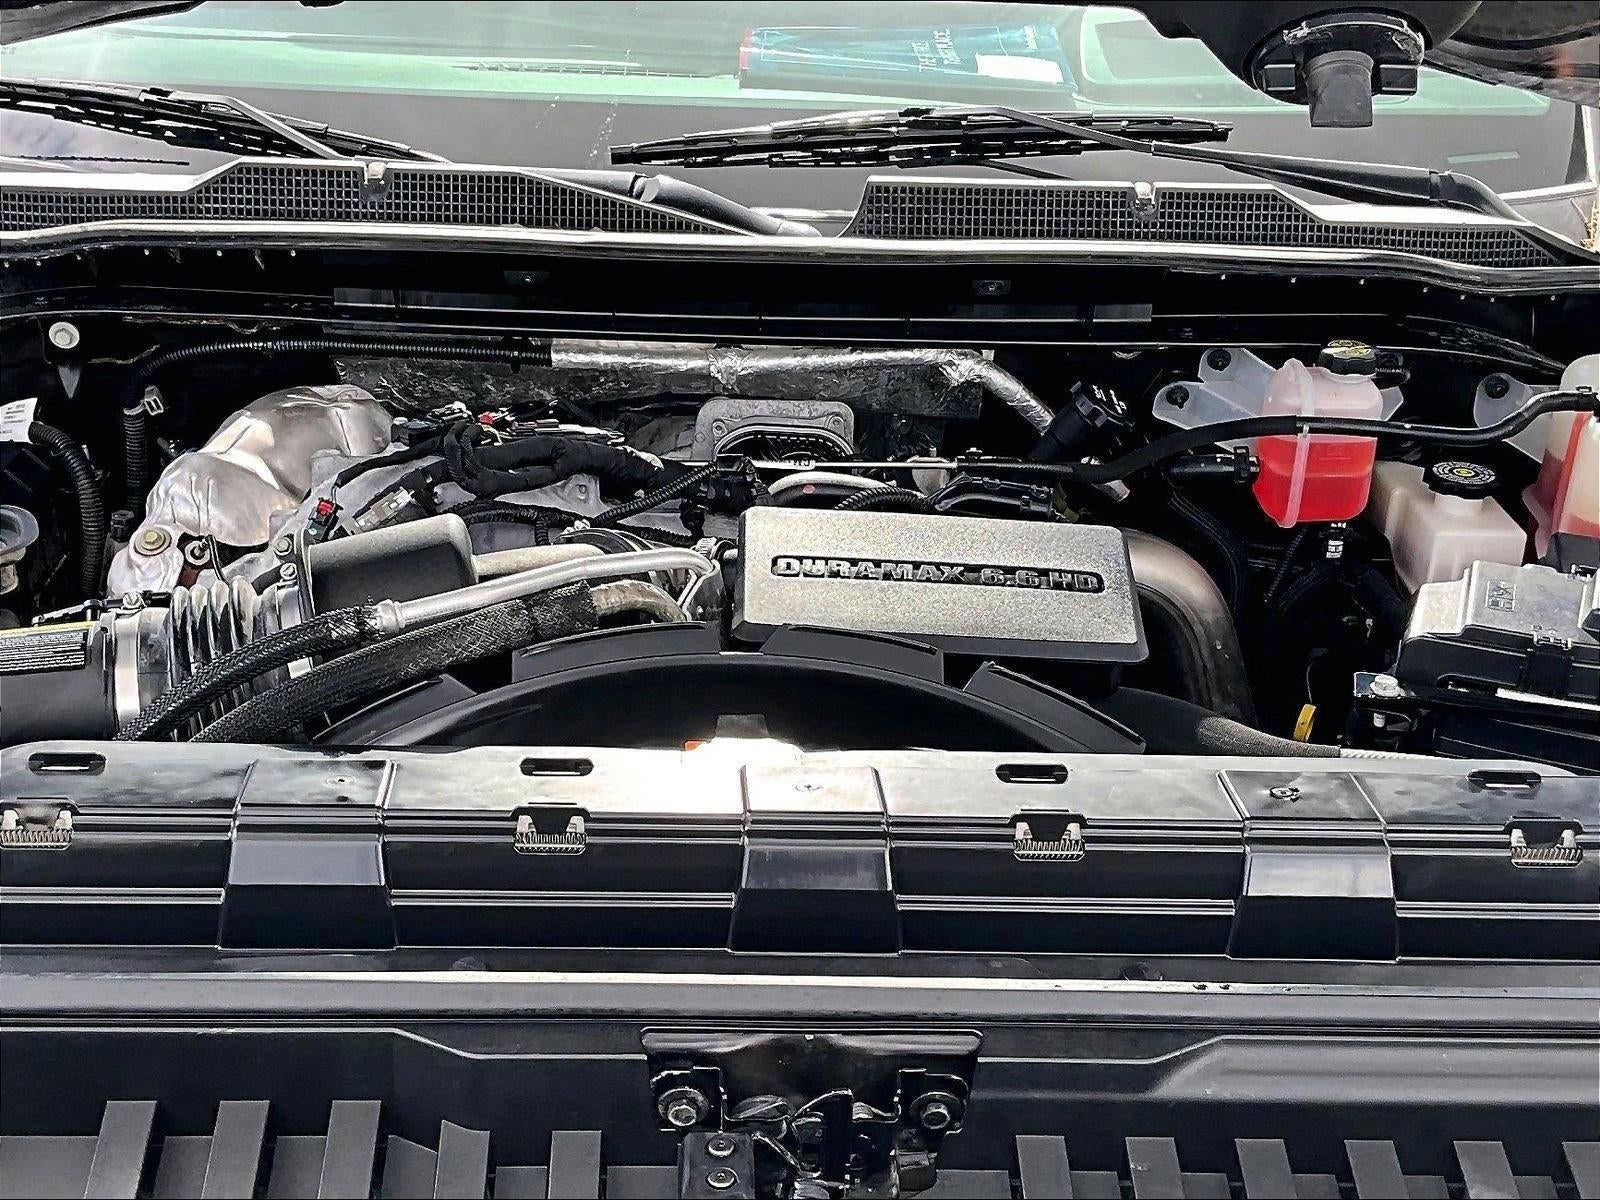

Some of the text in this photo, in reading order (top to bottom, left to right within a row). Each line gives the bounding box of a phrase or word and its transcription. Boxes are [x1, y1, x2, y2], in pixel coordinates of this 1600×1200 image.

[776, 557, 1101, 591] DURAMAX 6.6 HD
